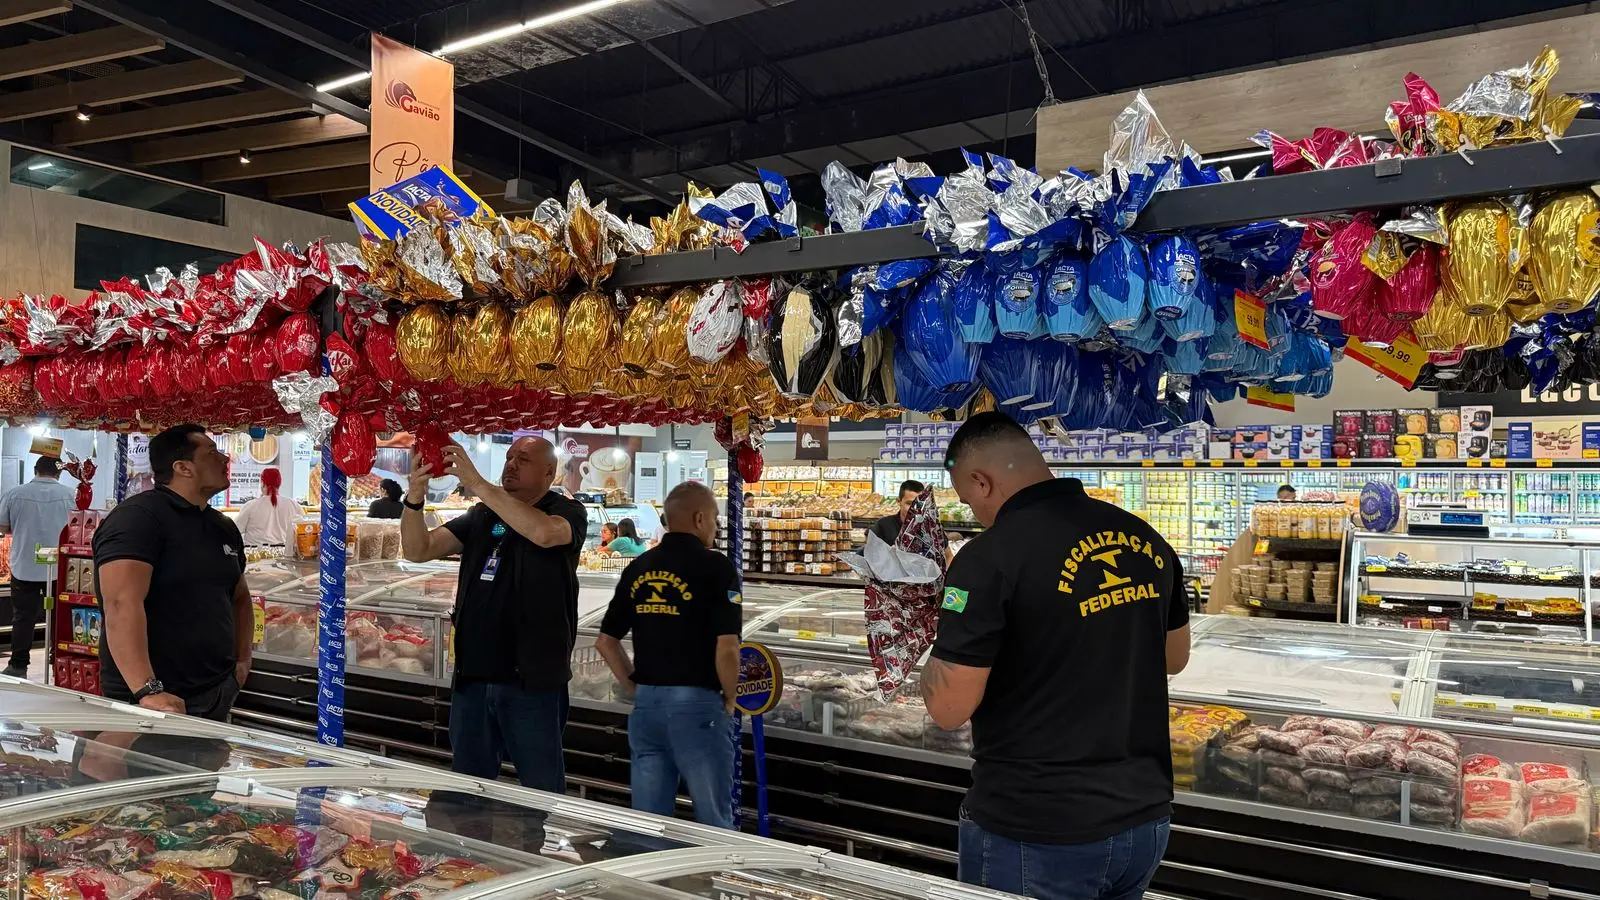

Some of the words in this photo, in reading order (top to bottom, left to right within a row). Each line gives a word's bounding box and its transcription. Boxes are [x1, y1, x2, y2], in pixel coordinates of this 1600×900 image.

[400, 95, 440, 121] Gavião
[402, 183, 432, 201] LACTA
[1176, 251, 1196, 266] LACTA
[1013, 271, 1033, 281] LACTA
[1055, 265, 1075, 274] LACTA
[329, 535, 345, 551] LACTA
[1058, 531, 1164, 594] FISCALIZAÇÃO
[1079, 583, 1160, 617] FEDERAL
[325, 661, 338, 671] LACTA
[325, 703, 344, 716] LACTA
[322, 732, 338, 746] LACTA
